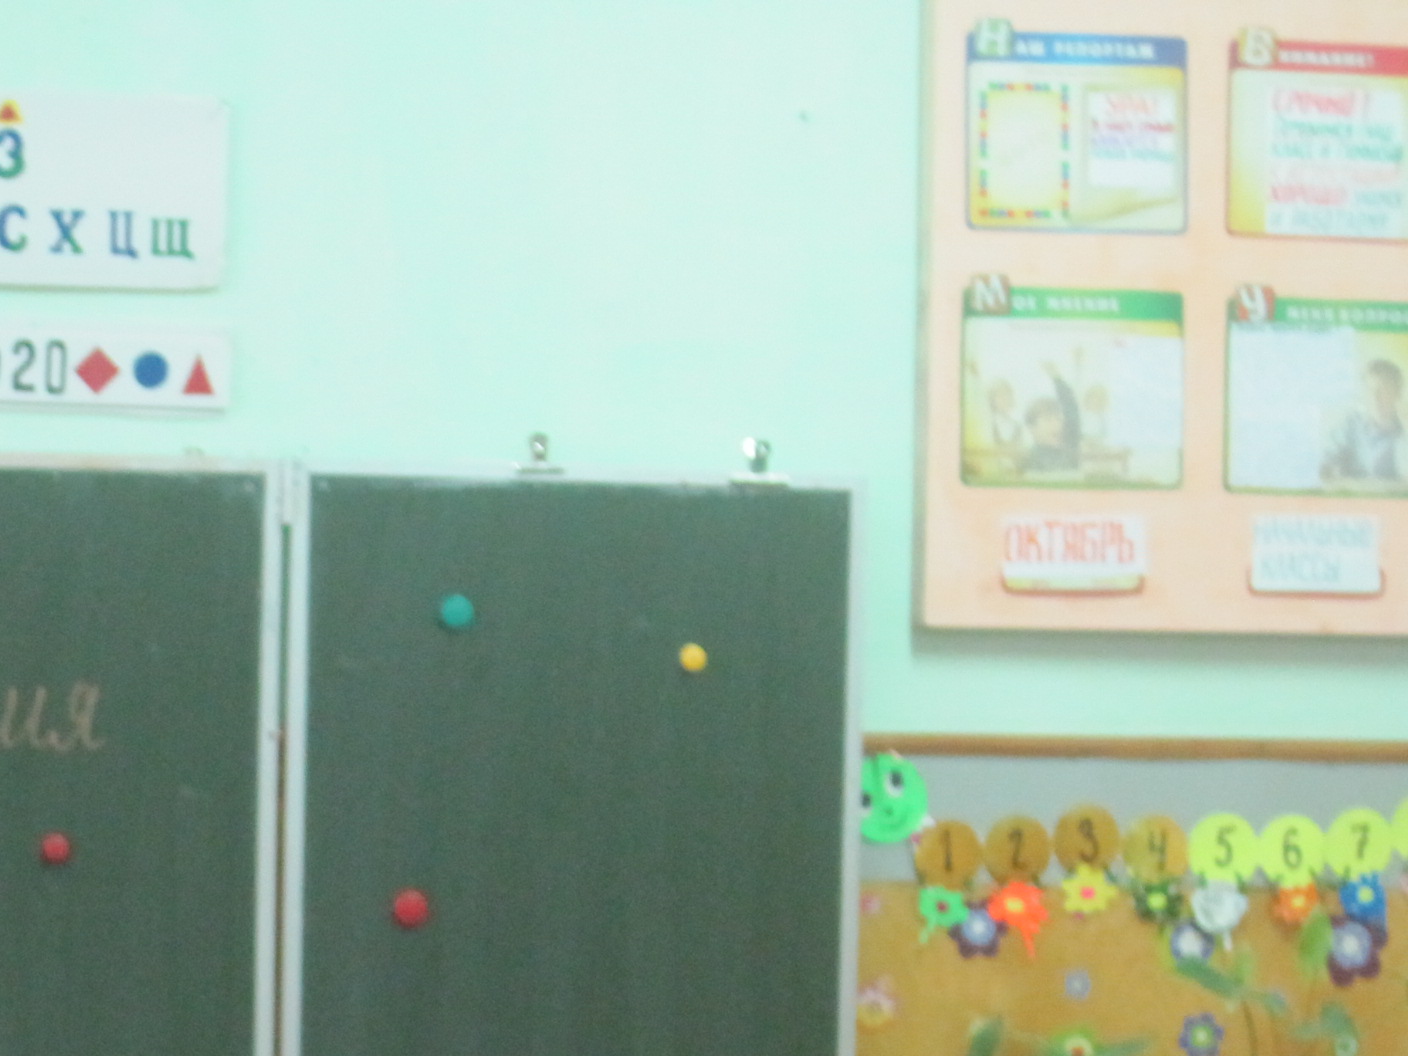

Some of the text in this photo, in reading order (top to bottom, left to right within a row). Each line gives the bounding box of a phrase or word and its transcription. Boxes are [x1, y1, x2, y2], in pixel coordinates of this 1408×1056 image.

[1007, 828, 1029, 871] 2
[1077, 817, 1100, 864] 3
[1148, 827, 1168, 872] 4
[1214, 825, 1237, 868] 5
[1281, 826, 1303, 870] 6
[1350, 821, 1371, 860] 7
